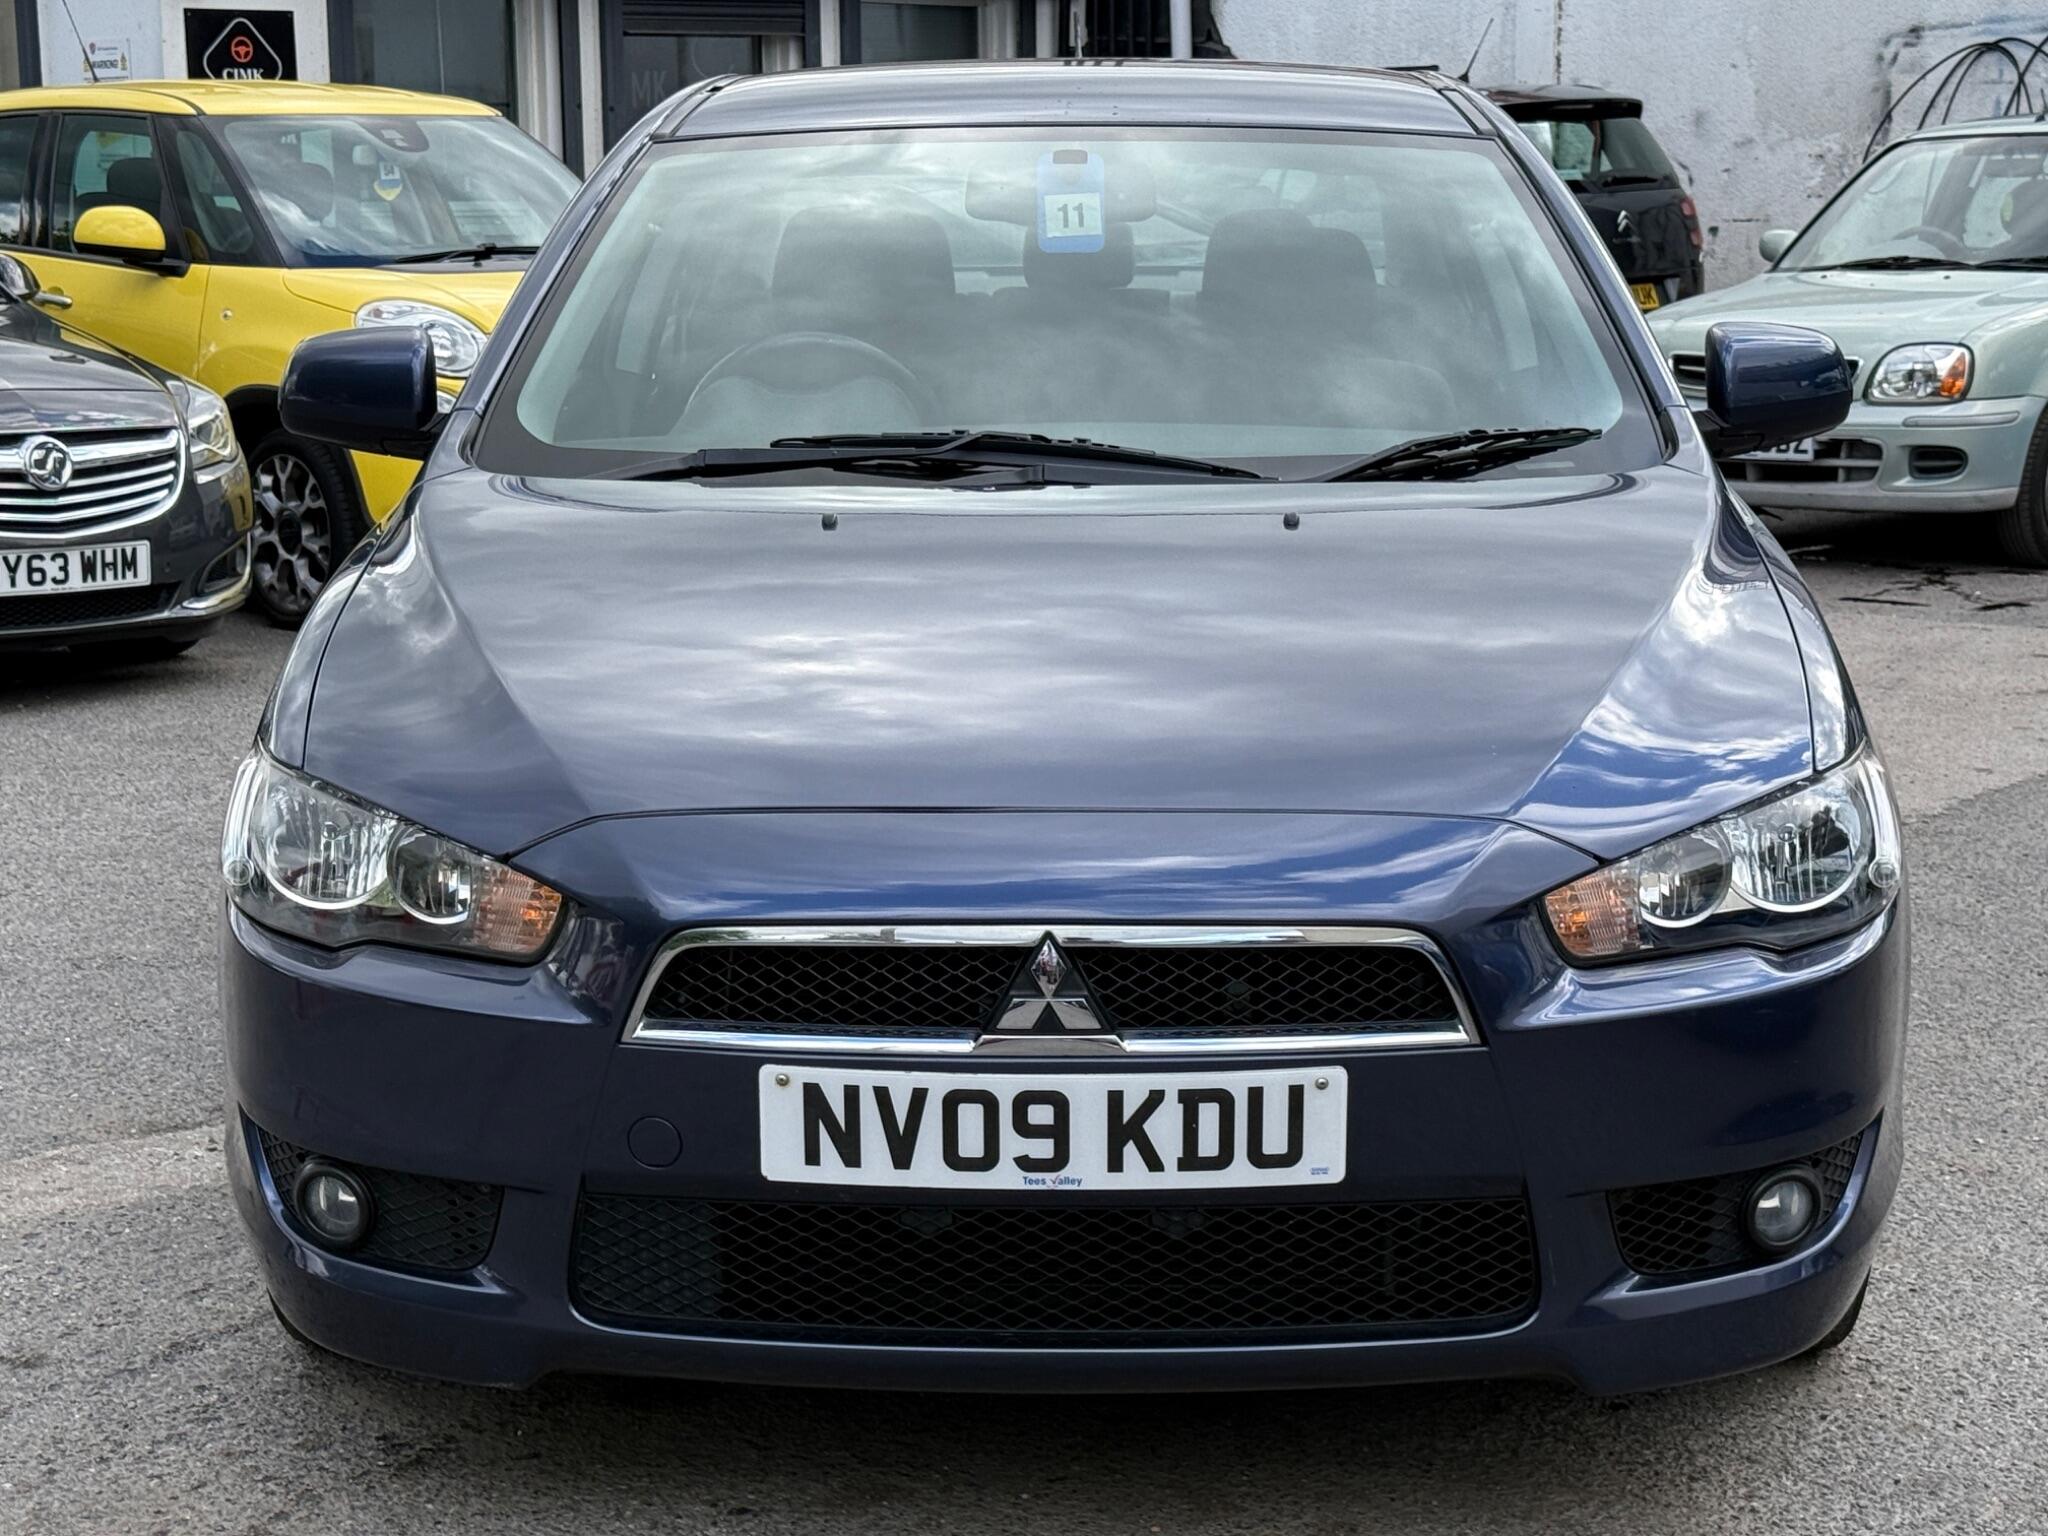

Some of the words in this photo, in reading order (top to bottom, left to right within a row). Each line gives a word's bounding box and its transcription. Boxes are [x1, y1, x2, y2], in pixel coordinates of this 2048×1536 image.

[1057, 202, 1085, 229] 11
[2, 553, 70, 588] Y63
[80, 547, 138, 583] WHM
[802, 1082, 1070, 1173] NV09
[1106, 1083, 1305, 1173] KDU
[1022, 1175, 1047, 1185] Tees
